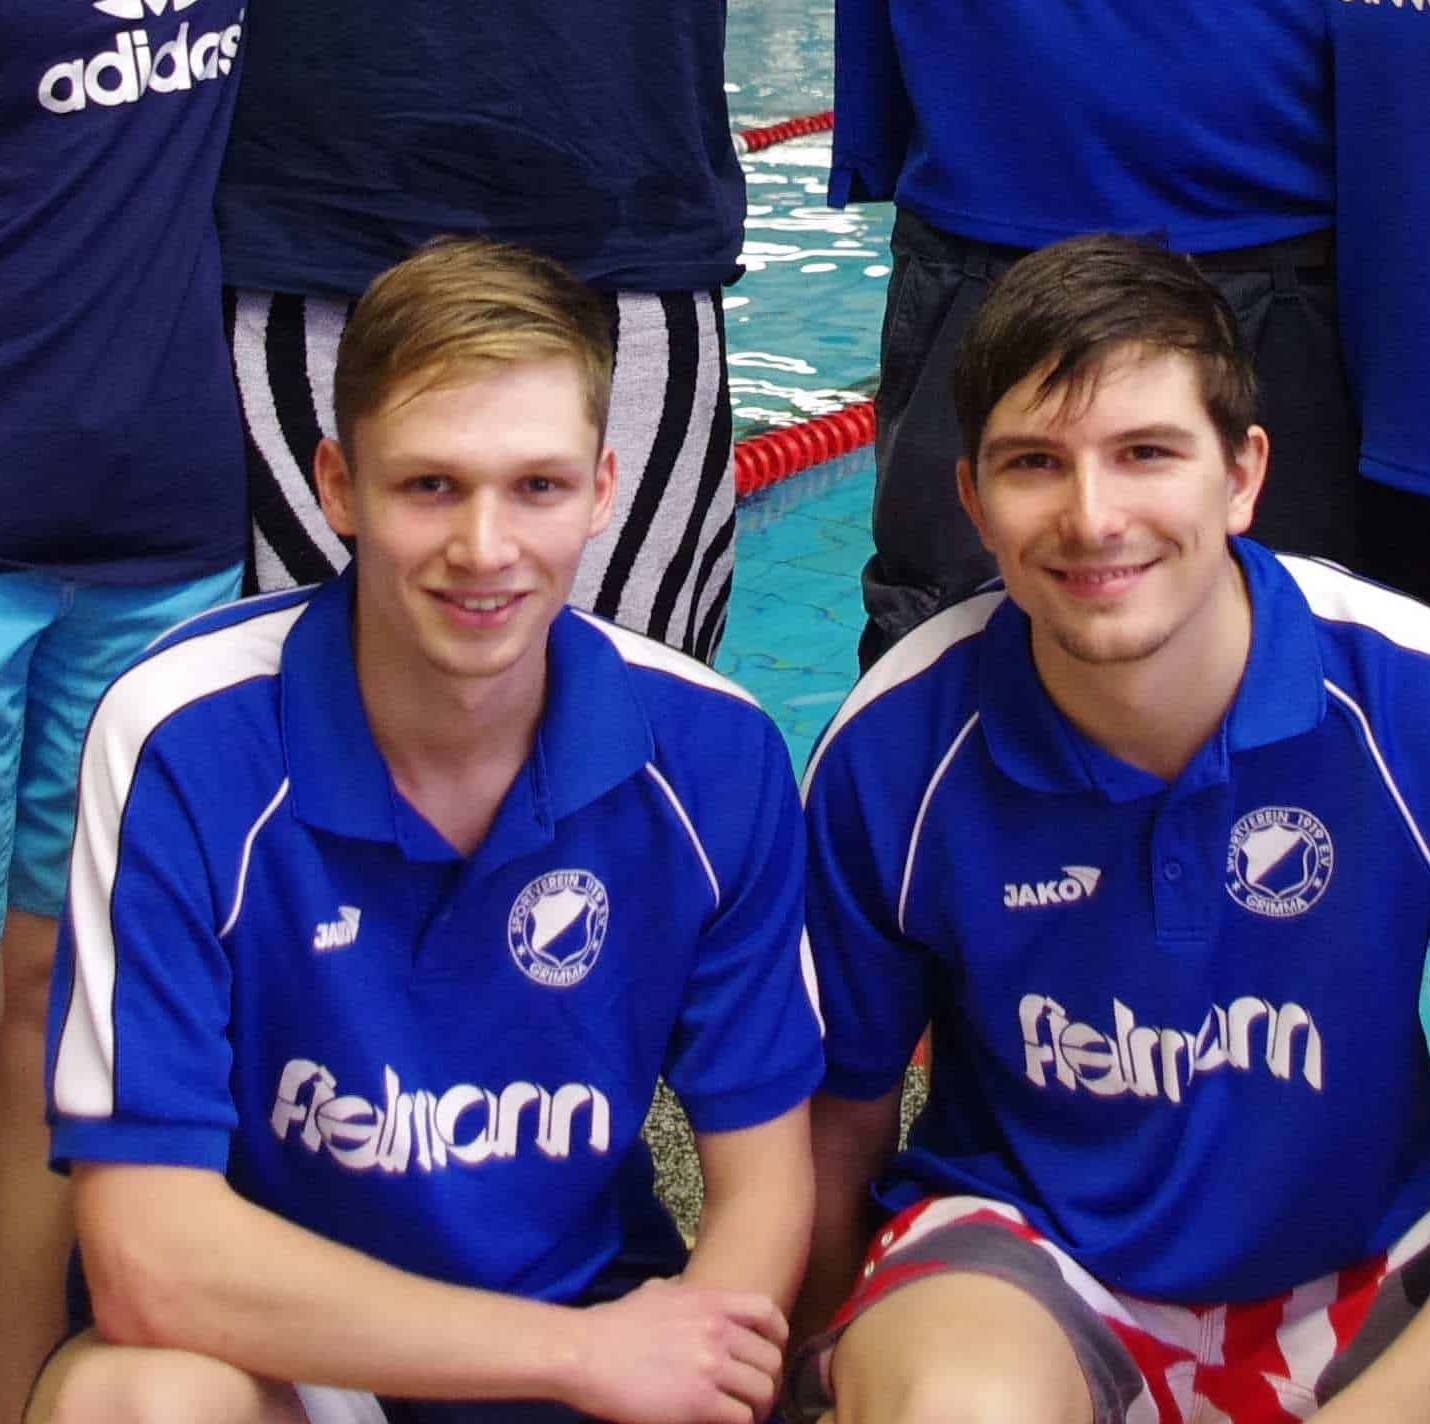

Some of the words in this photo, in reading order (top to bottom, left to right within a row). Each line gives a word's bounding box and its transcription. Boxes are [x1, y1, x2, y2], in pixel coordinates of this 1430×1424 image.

[37, 21, 245, 114] adidas
[1004, 877, 1084, 908] JAKO
[1246, 895, 1308, 915] GRIMMA
